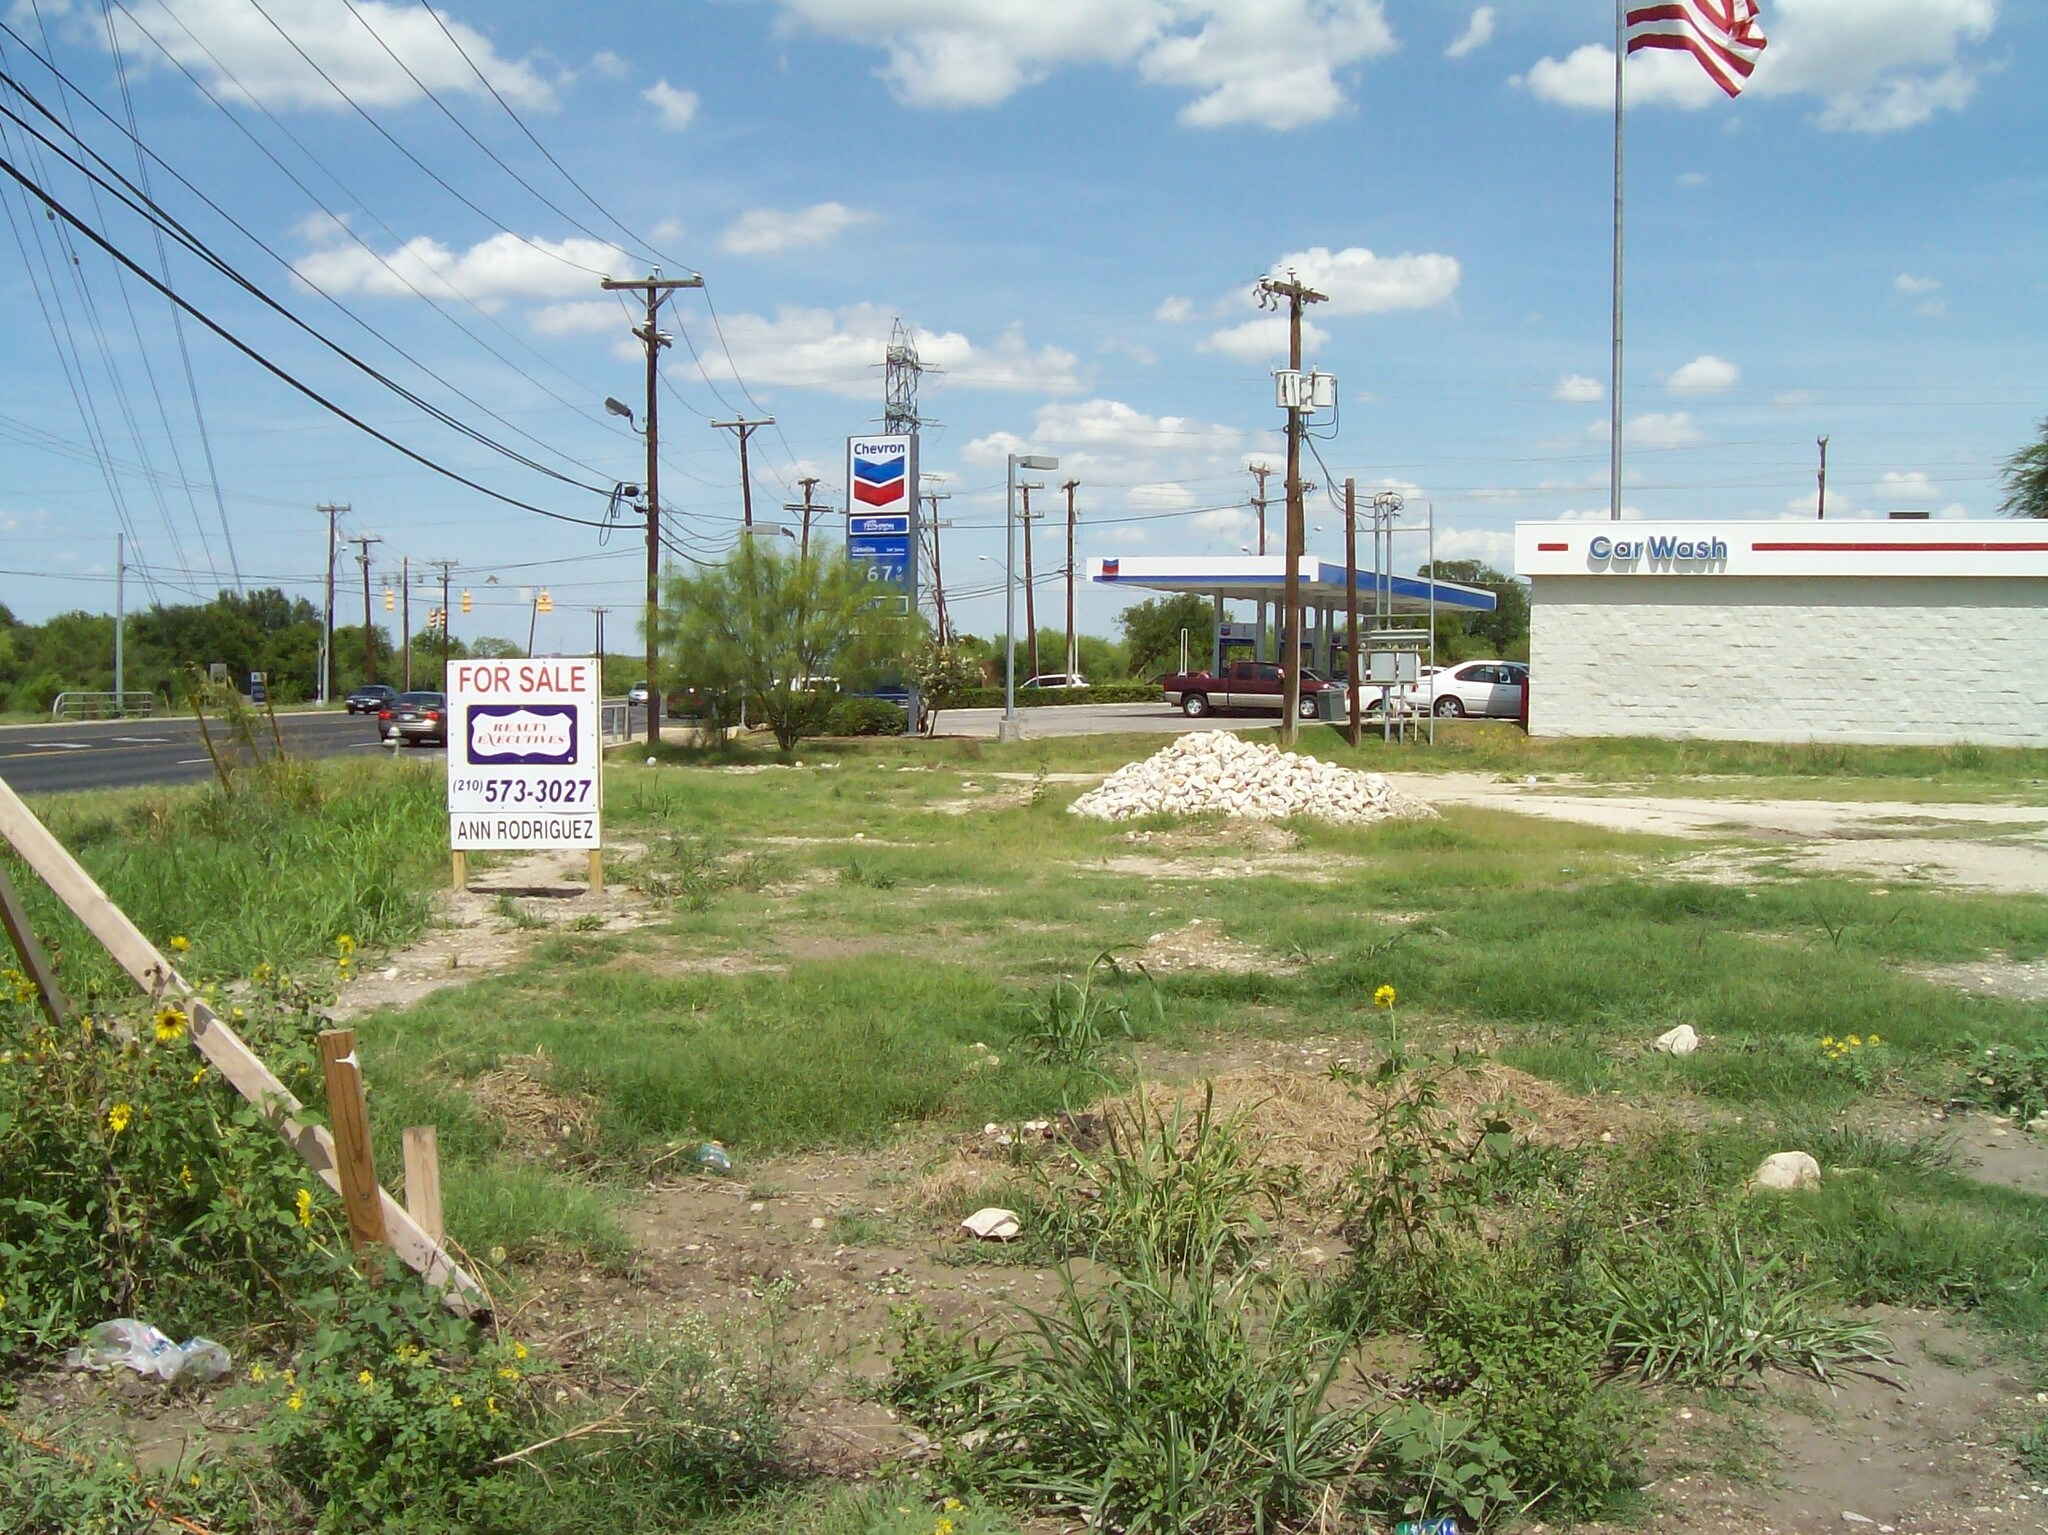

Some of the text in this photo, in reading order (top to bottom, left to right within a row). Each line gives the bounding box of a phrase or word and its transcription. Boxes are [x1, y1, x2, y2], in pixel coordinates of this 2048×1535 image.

[854, 443, 905, 455] Chevron
[1590, 536, 1728, 559] Car Wash
[459, 666, 585, 693] FOR SALE
[493, 723, 547, 732] REALTY
[477, 734, 565, 747] EXECUTIVES
[453, 779, 591, 803] (210) 573-3027
[458, 820, 593, 840] ANN RODRIGUEZ
